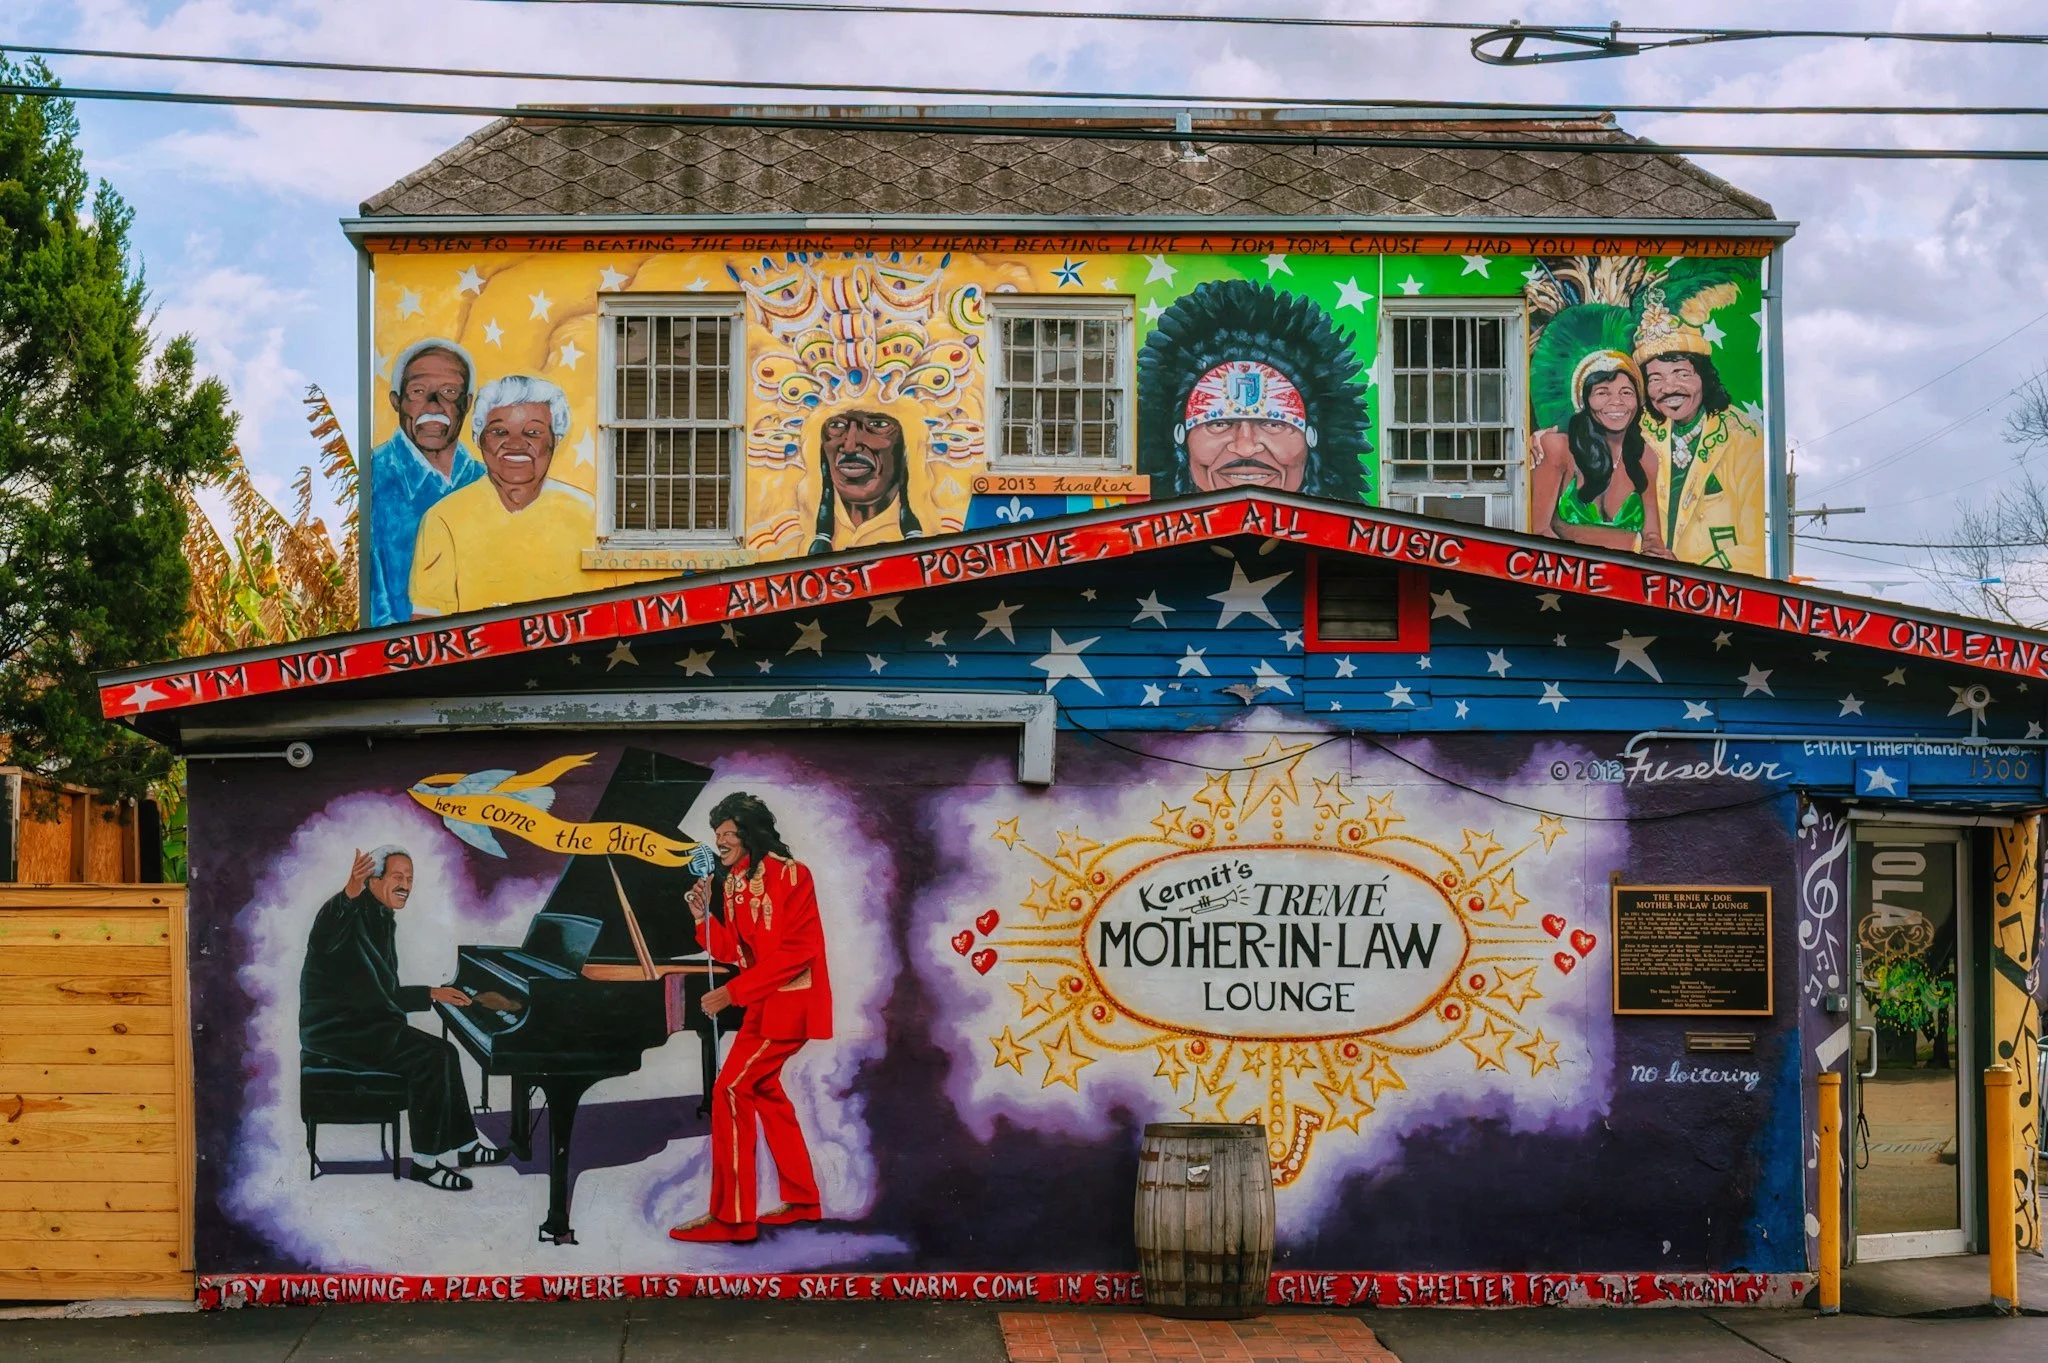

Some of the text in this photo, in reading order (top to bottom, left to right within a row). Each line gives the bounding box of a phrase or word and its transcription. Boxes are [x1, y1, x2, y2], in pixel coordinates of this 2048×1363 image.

[389, 236, 470, 252] LISTEN
[482, 236, 508, 252] TO
[528, 237, 568, 252] THE
[690, 237, 732, 252] THE
[742, 237, 834, 252] BEATING
[854, 238, 878, 252] OF
[891, 238, 924, 251] MY
[1014, 238, 1110, 252] BEATING
[1128, 239, 1179, 253] LIKE
[1199, 239, 1213, 252] A
[1231, 238, 1274, 253] TOM
[1443, 239, 1451, 252] I
[1465, 239, 1512, 254] HAD
[1529, 240, 1575, 255] YOU
[1592, 240, 1622, 254] ON
[1635, 240, 1667, 255] MY
[998, 477, 1036, 493] 2013
[279, 650, 357, 689] NOT
[384, 629, 491, 671] SURE
[520, 608, 592, 648] BUT
[632, 594, 688, 631] I'M
[726, 560, 883, 618] ALMOST
[1121, 507, 1220, 550] THAT
[1240, 501, 1308, 540] ALL
[1348, 517, 1466, 567] MUSIC
[1506, 549, 1613, 592] CAME
[1641, 572, 1743, 620] FROM
[1778, 596, 1870, 641] NEW
[434, 796, 467, 817] here
[555, 826, 593, 850] the
[606, 824, 657, 857] girls
[1138, 860, 1253, 912] Kermit's
[1252, 875, 1391, 917] TREMÉ
[1653, 893, 1733, 903] THE ERNIE K-DOE
[1872, 842, 1926, 929] OLA
[1636, 901, 1749, 911] MOTHER-IN-LAW LOUNGE
[1098, 916, 1442, 969] MOTHER-IN-LAW
[1203, 981, 1356, 1013] LOUNGE
[1630, 1060, 1761, 1092] no loitering
[281, 1277, 410, 1300] IMAGINING
[421, 1278, 436, 1298] A
[445, 1276, 526, 1299] PLACE
[542, 1276, 625, 1300] WHERE
[695, 1276, 782, 1298] ALWAYS
[799, 1276, 859, 1299] SAFE
[973, 1275, 1039, 1299] COME
[1059, 1276, 1081, 1298] IN
[1094, 1275, 1144, 1300] SHE
[1277, 1275, 1338, 1302] GIVE
[1351, 1275, 1382, 1299] YA
[1397, 1274, 1515, 1305] SHELTER
[1527, 1274, 1587, 1304] FROM
